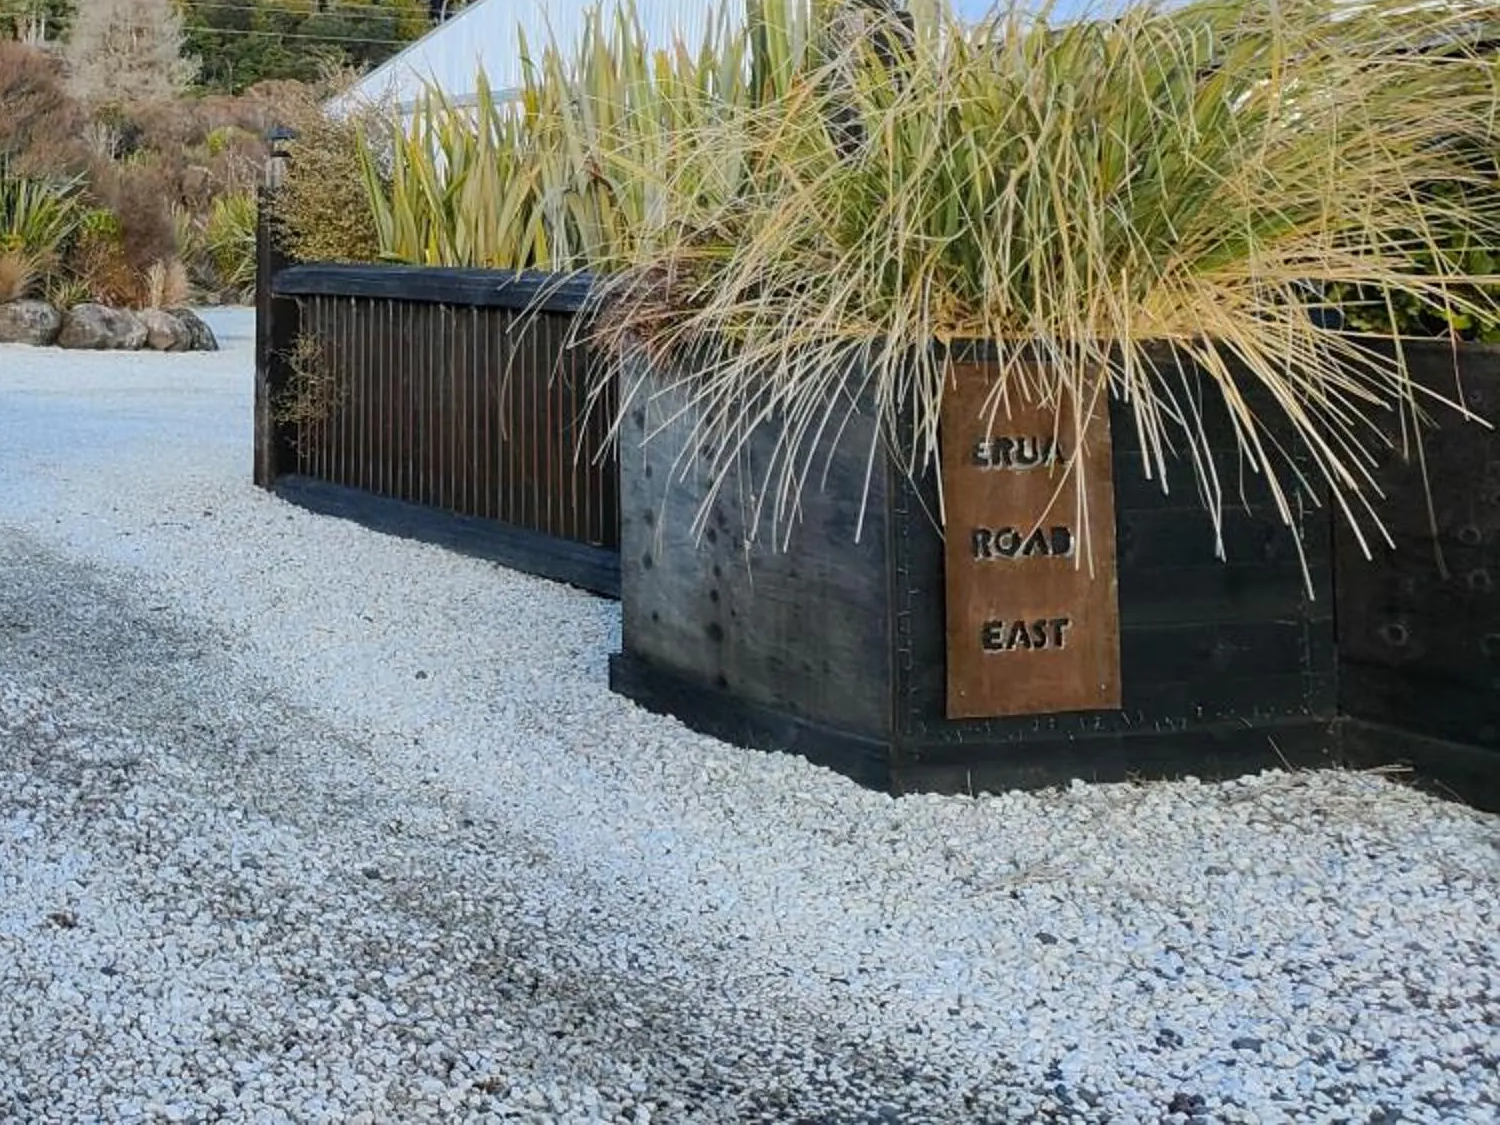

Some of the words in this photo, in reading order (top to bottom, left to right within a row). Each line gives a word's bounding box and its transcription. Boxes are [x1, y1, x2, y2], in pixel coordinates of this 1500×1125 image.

[971, 435, 1066, 469] ERUA
[972, 526, 1073, 560] ROAD
[981, 618, 1070, 652] EAST
